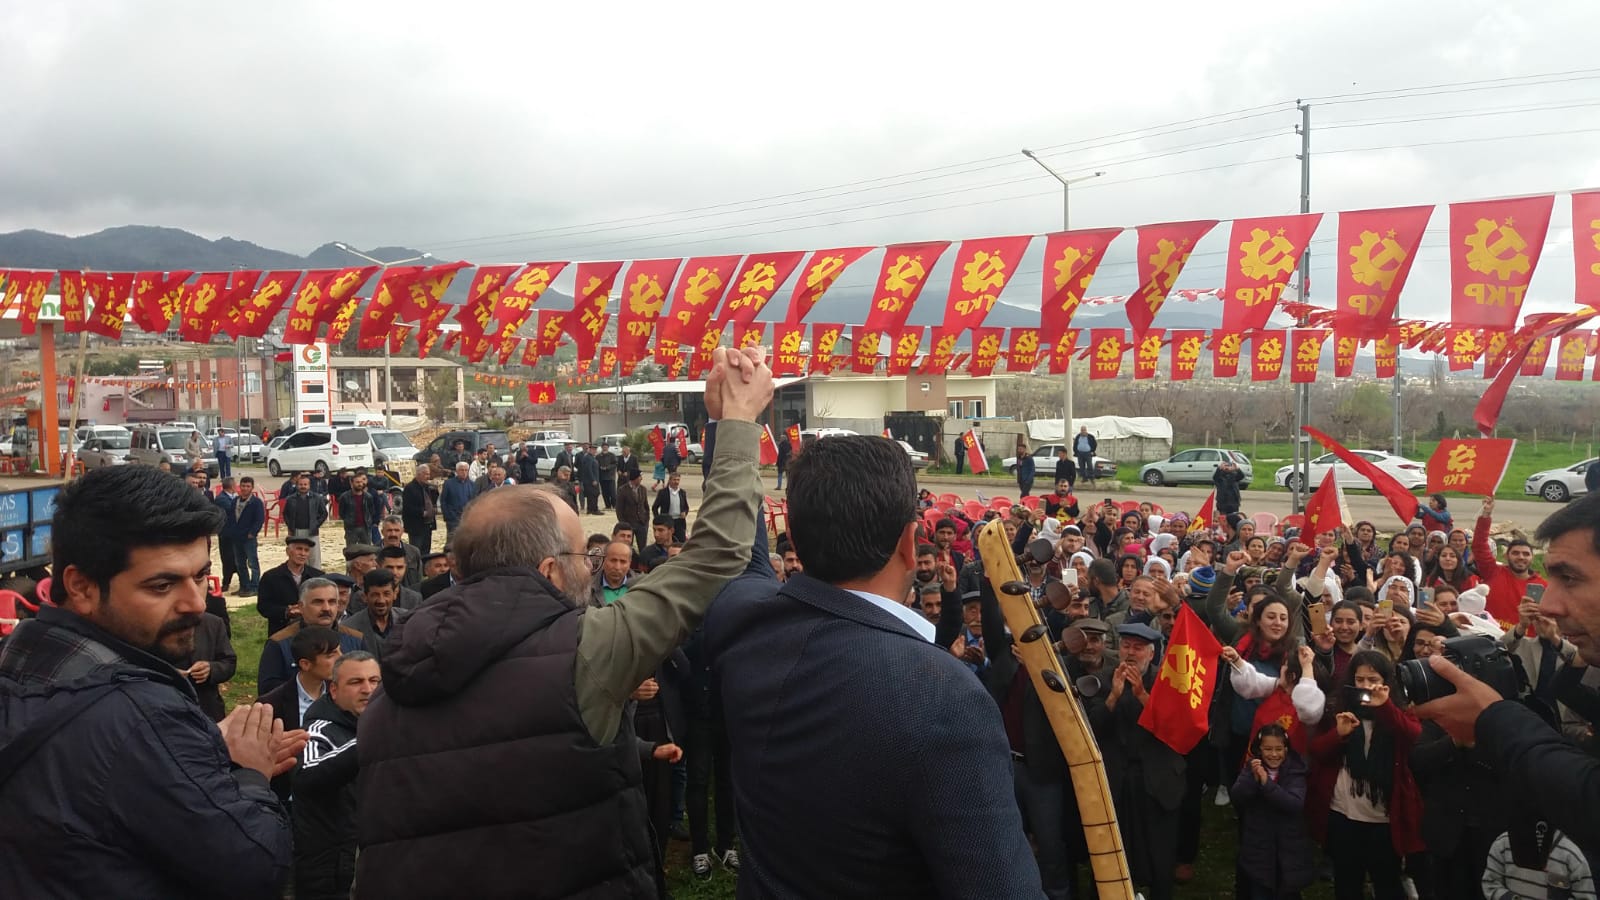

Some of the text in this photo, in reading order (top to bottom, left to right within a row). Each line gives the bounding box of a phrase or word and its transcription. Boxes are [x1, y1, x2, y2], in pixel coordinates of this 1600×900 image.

[1142, 273, 1166, 317] TK
[1014, 355, 1034, 364] TKP
[1096, 362, 1119, 371] TKP
[1257, 363, 1280, 372] TKP
